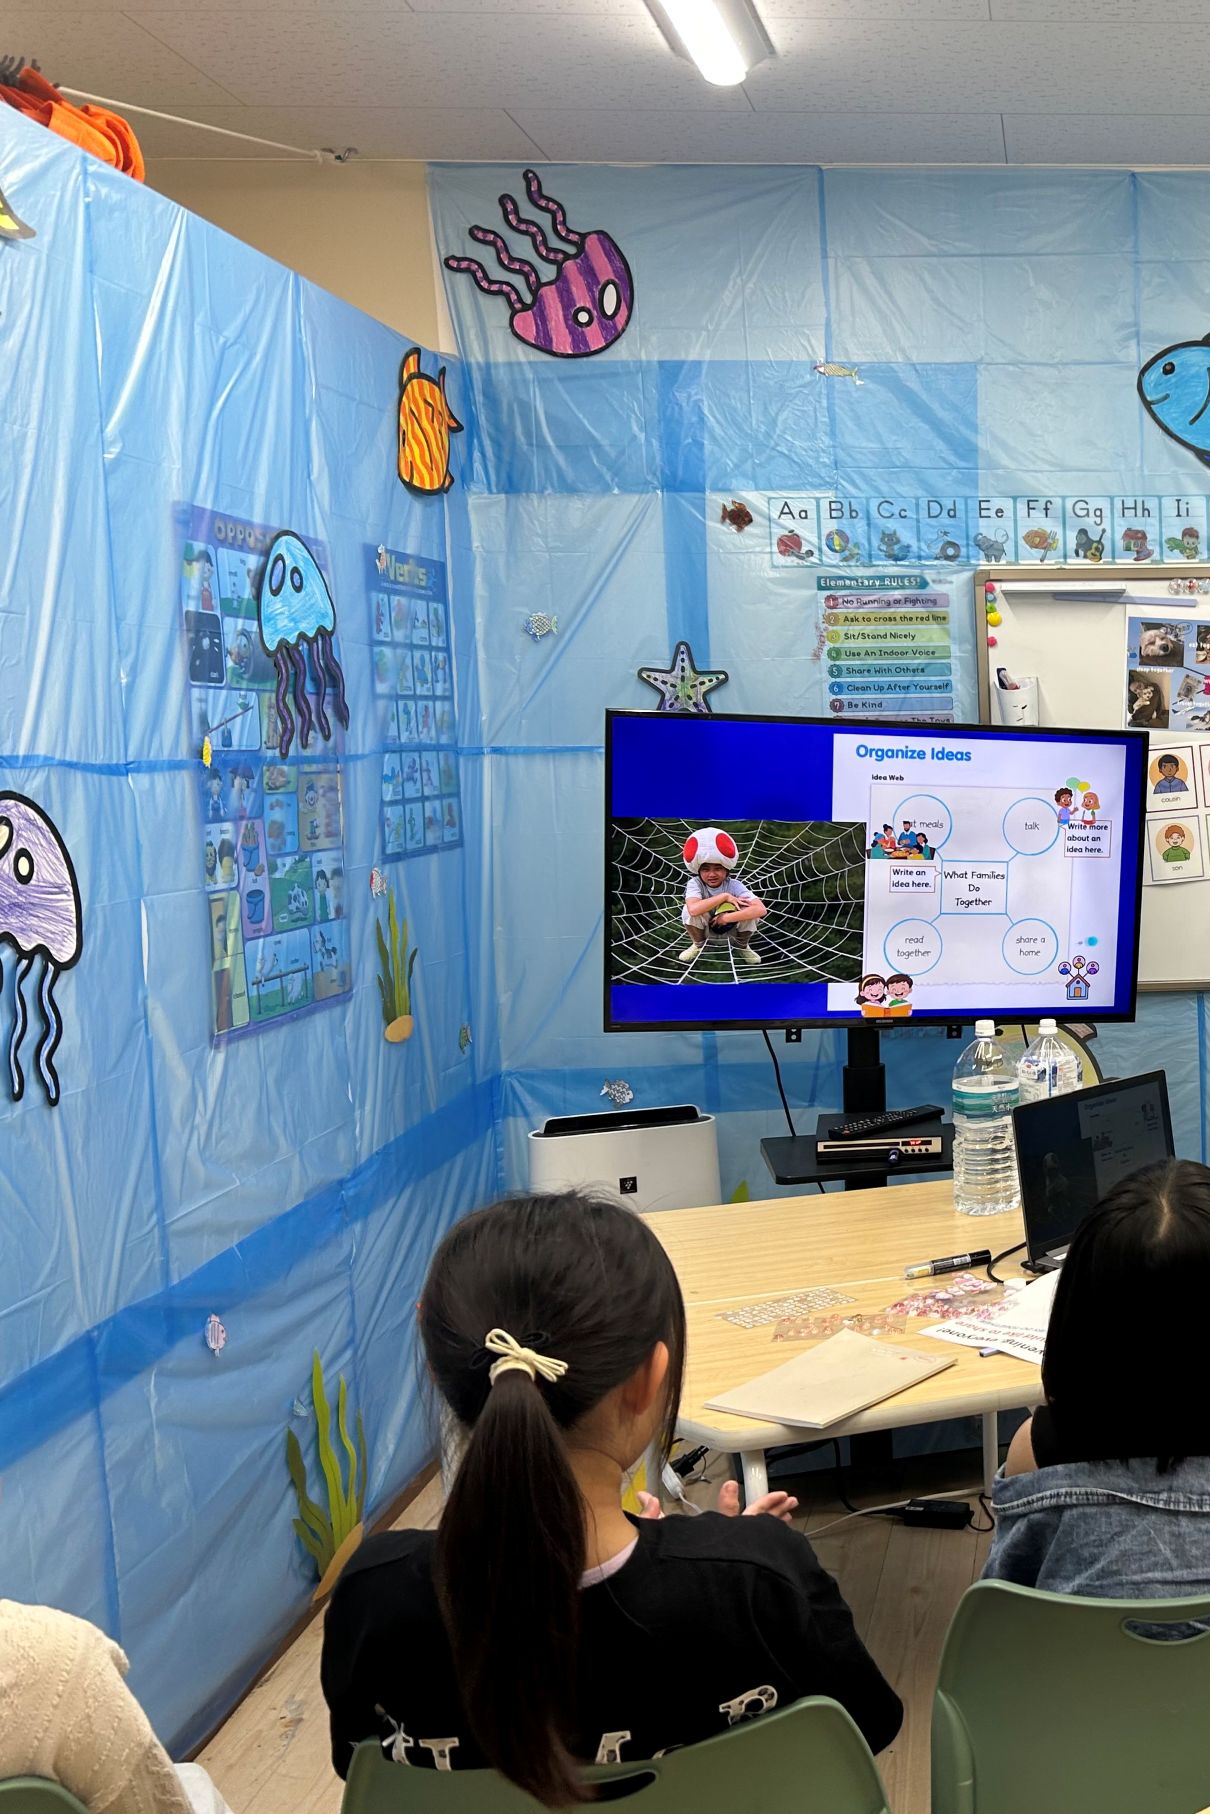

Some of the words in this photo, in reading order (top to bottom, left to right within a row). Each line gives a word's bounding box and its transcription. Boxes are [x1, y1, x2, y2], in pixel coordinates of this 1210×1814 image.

[820, 577, 880, 589] Elementary
[884, 576, 921, 586] RULES!
[842, 598, 854, 606] No
[857, 597, 891, 607] Running
[904, 596, 938, 607] Fighting
[843, 615, 859, 623] Ask
[900, 614, 914, 622] the
[915, 614, 930, 622] red
[932, 613, 947, 622] line
[843, 631, 888, 641] Sit/Stand
[889, 632, 916, 642] Nicely
[864, 649, 877, 657] An
[879, 648, 910, 657] Indoor
[911, 648, 936, 657] Voice
[845, 667, 872, 675] Share
[873, 666, 893, 675] With
[894, 666, 925, 674] Others
[846, 684, 872, 692] Clean
[873, 684, 885, 693] Up
[886, 683, 911, 691] After
[912, 682, 950, 691] Yourself
[847, 701, 859, 709] Be
[861, 700, 883, 709] Kind
[856, 744, 927, 762] Organize
[931, 747, 972, 762] Ideas
[889, 774, 905, 782] Web
[1161, 795, 1181, 803] cousin
[919, 820, 944, 829] meals
[1024, 821, 1040, 831] talk
[1067, 822, 1088, 831] Write
[1067, 834, 1090, 842] about
[1066, 845, 1083, 853] idea
[1084, 846, 1104, 854] here.
[892, 868, 914, 876] Write
[943, 870, 968, 880] What
[971, 870, 1005, 880] Families
[891, 879, 910, 888] idea
[911, 880, 932, 888] here.
[968, 883, 981, 892] Do
[954, 897, 992, 909] Together
[904, 935, 925, 944] read
[1015, 935, 1038, 944] share
[896, 948, 932, 960] together
[1019, 948, 1041, 957] home
